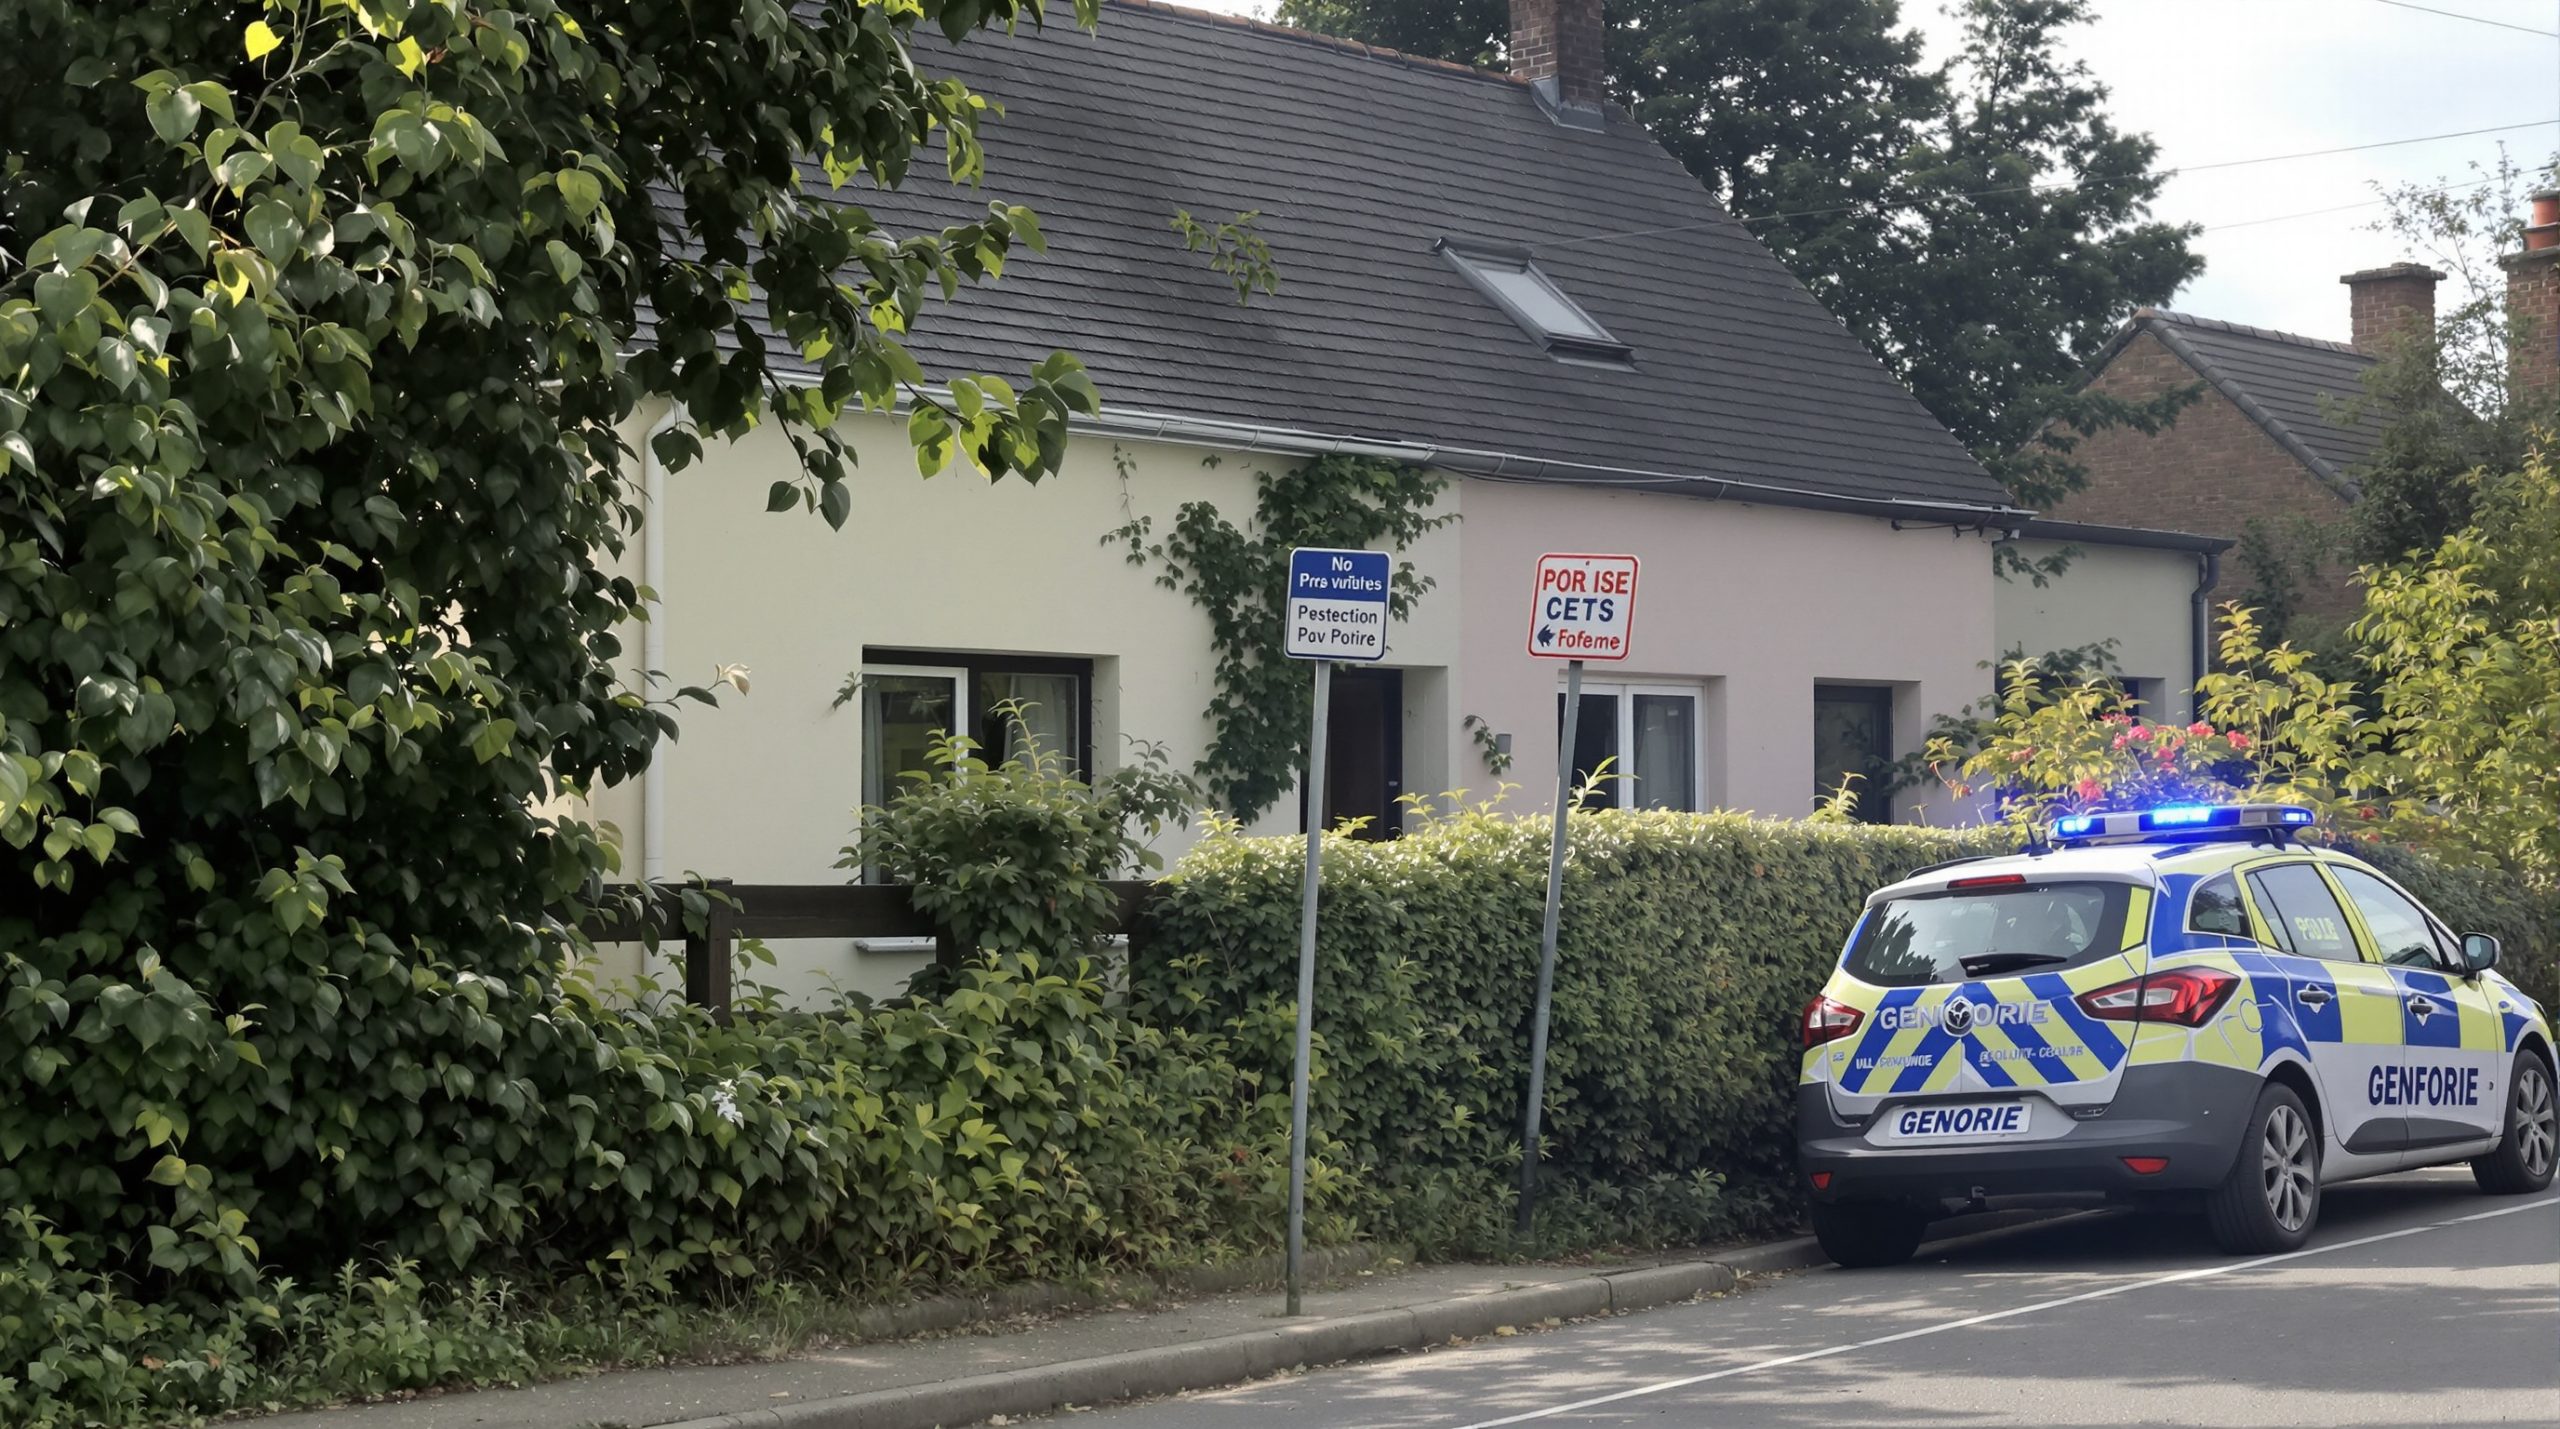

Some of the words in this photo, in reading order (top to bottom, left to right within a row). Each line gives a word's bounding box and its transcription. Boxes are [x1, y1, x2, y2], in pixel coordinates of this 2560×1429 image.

[1331, 556, 1353, 572] No
[1542, 568, 1586, 593] POR
[1593, 570, 1630, 595] ISE
[1298, 604, 1378, 625] Pestection
[1546, 596, 1614, 622] CETS
[2368, 1065, 2479, 1106] GENFORIE
[1900, 1105, 2023, 1135] GENORIE
